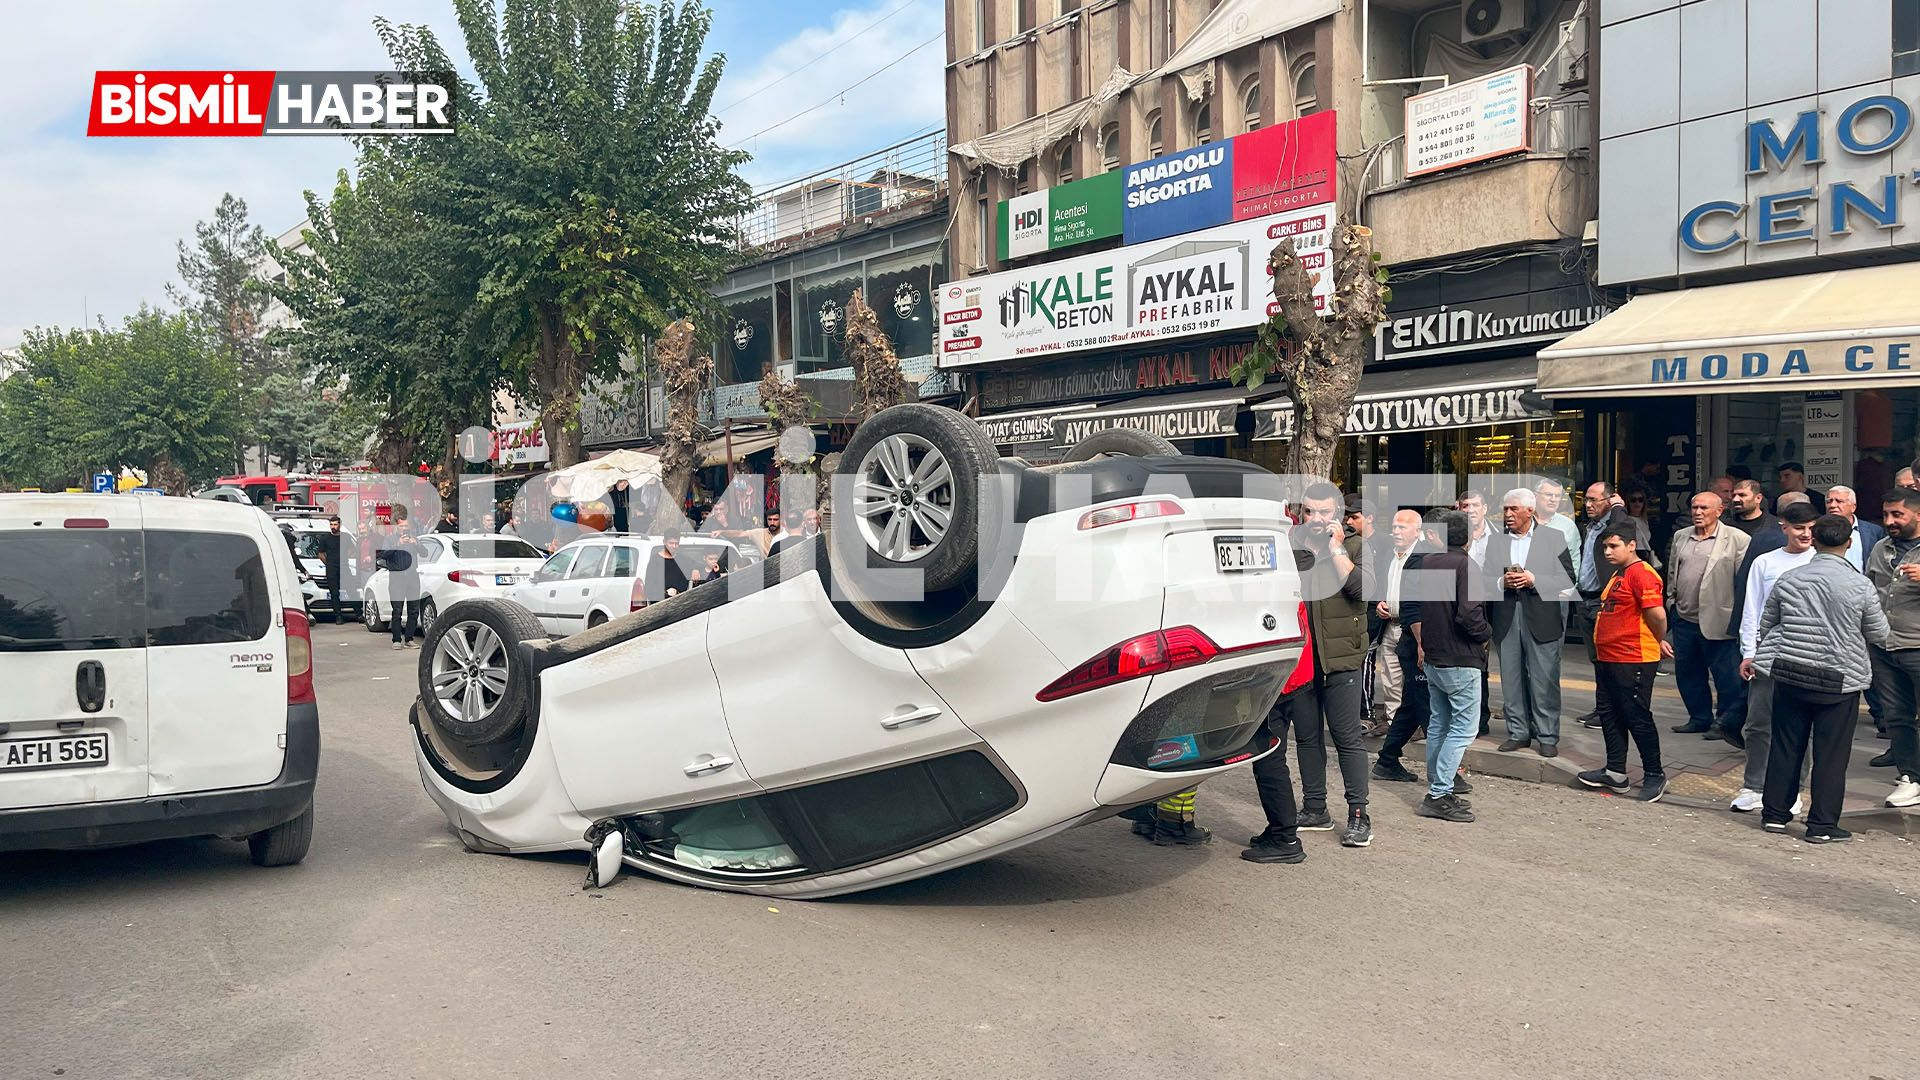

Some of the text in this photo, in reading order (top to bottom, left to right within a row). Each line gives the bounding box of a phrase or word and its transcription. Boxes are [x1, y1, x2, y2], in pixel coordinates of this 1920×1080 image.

[1127, 147, 1225, 188] ANADOLU
[1127, 174, 1213, 209] SİGORTA
[1015, 208, 1042, 231] HDI
[1054, 202, 1088, 221] Acentesi
[1271, 224, 1297, 238] PARKE
[1302, 218, 1322, 231] BİMS
[1305, 255, 1323, 268] TAŞI
[1140, 262, 1234, 305] AYKAL
[1031, 266, 1113, 329] KALE
[1139, 295, 1233, 323] PREFABRİK
[961, 310, 978, 320] BETON
[1057, 303, 1113, 329] BETON
[1131, 329, 1155, 339] AYKAL
[1161, 324, 1180, 335] 0532
[1182, 322, 1196, 333] 653
[1198, 320, 1209, 330] 19
[1210, 319, 1221, 328] 87
[1016, 346, 1039, 355] Selman
[1039, 342, 1061, 352] AYKAL
[1066, 337, 1082, 348] 0532
[1084, 336, 1097, 345] 588
[1136, 352, 1199, 389] AYKAL
[1651, 343, 1911, 383] MODA CE
[1345, 388, 1529, 433] KUYUMCULUK
[1807, 408, 1823, 420] LTB
[980, 421, 1010, 438] İDYAT
[1112, 409, 1220, 437] KUYUMCULUK
[500, 426, 543, 450] ECZANE
[96, 476, 107, 490] P
[1807, 474, 1838, 485] BENSU
[1219, 546, 1232, 566] 38
[230, 653, 273, 662] nemo
[7, 739, 102, 765] AFH 565
